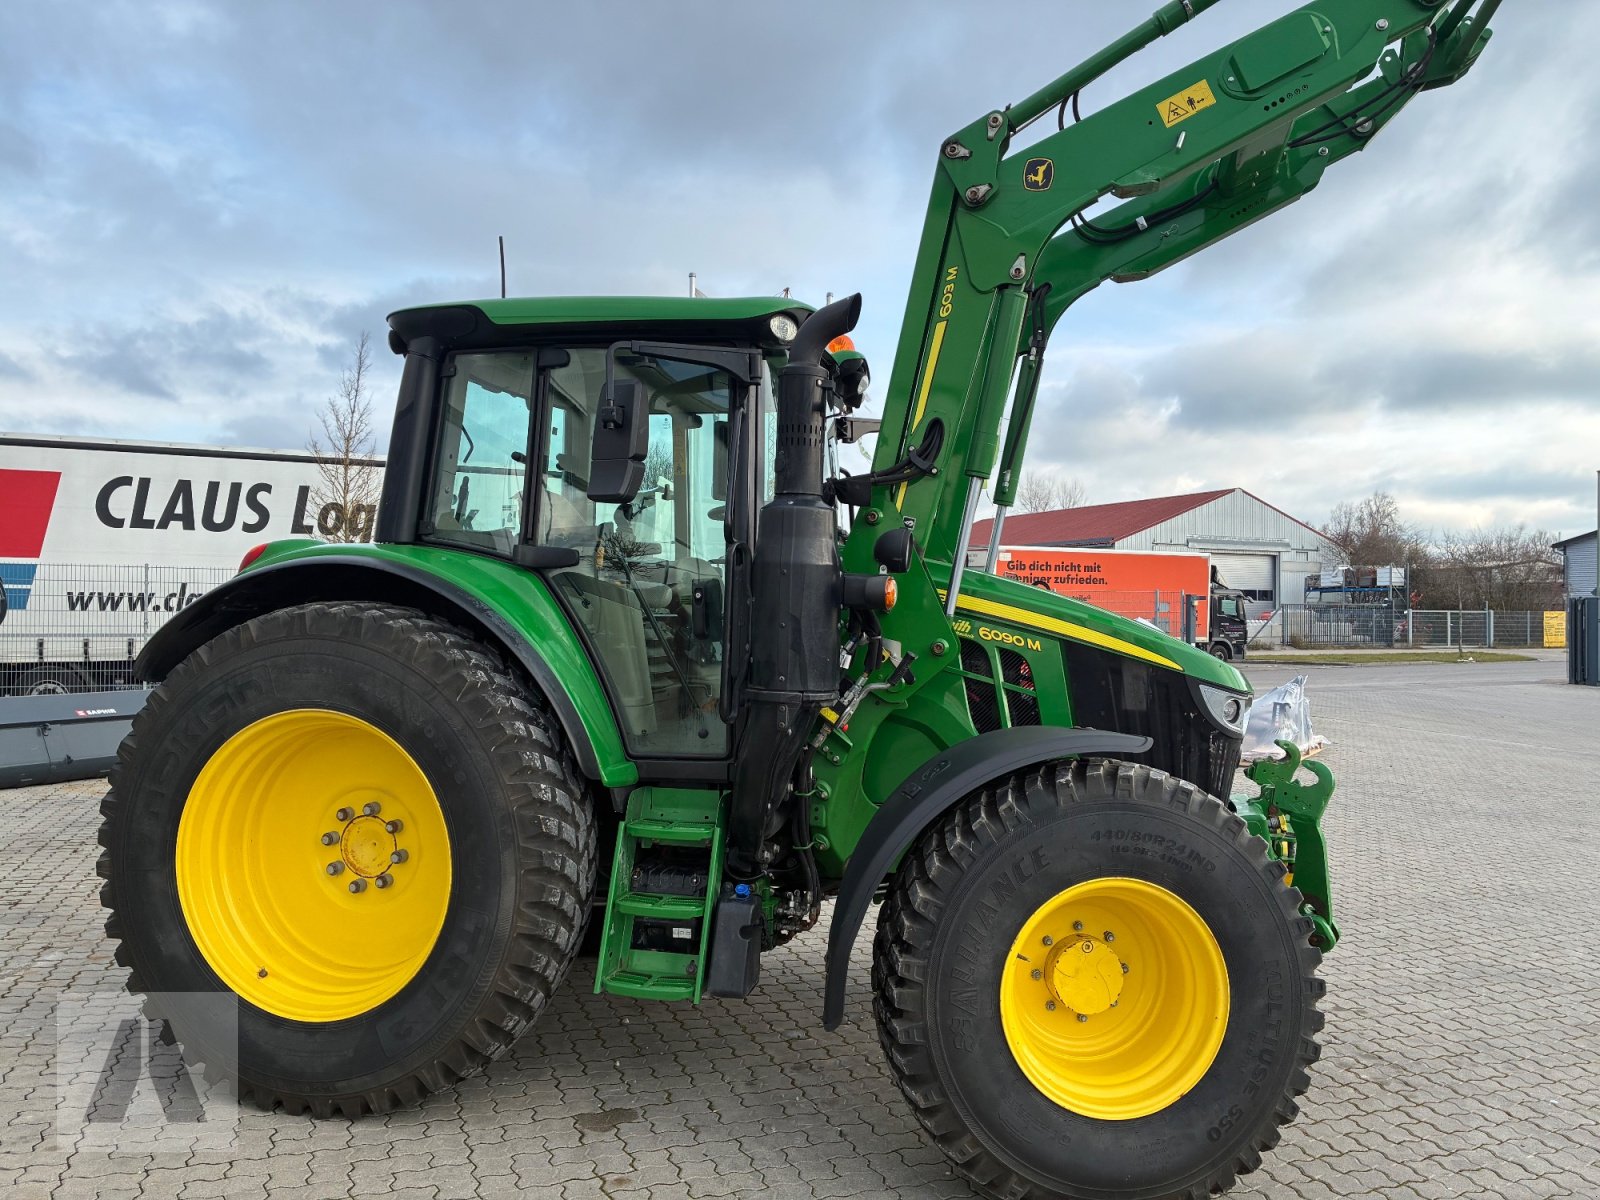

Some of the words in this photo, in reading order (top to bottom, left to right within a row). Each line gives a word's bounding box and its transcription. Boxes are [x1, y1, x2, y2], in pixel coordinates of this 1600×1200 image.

[946, 266, 958, 280] M
[940, 283, 954, 317] 603
[95, 475, 273, 533] CLAUS
[1005, 573, 1052, 586] eniger
[1053, 573, 1109, 585] zufrieden.
[1006, 560, 1027, 571] Gib
[1029, 561, 1052, 572] dich
[1054, 562, 1082, 573] nicht
[1084, 562, 1102, 573] mit
[978, 626, 1025, 648] 6090
[1027, 638, 1042, 652] M
[951, 844, 1051, 1017] ALLIANCE
[1206, 1103, 1245, 1143] 550
